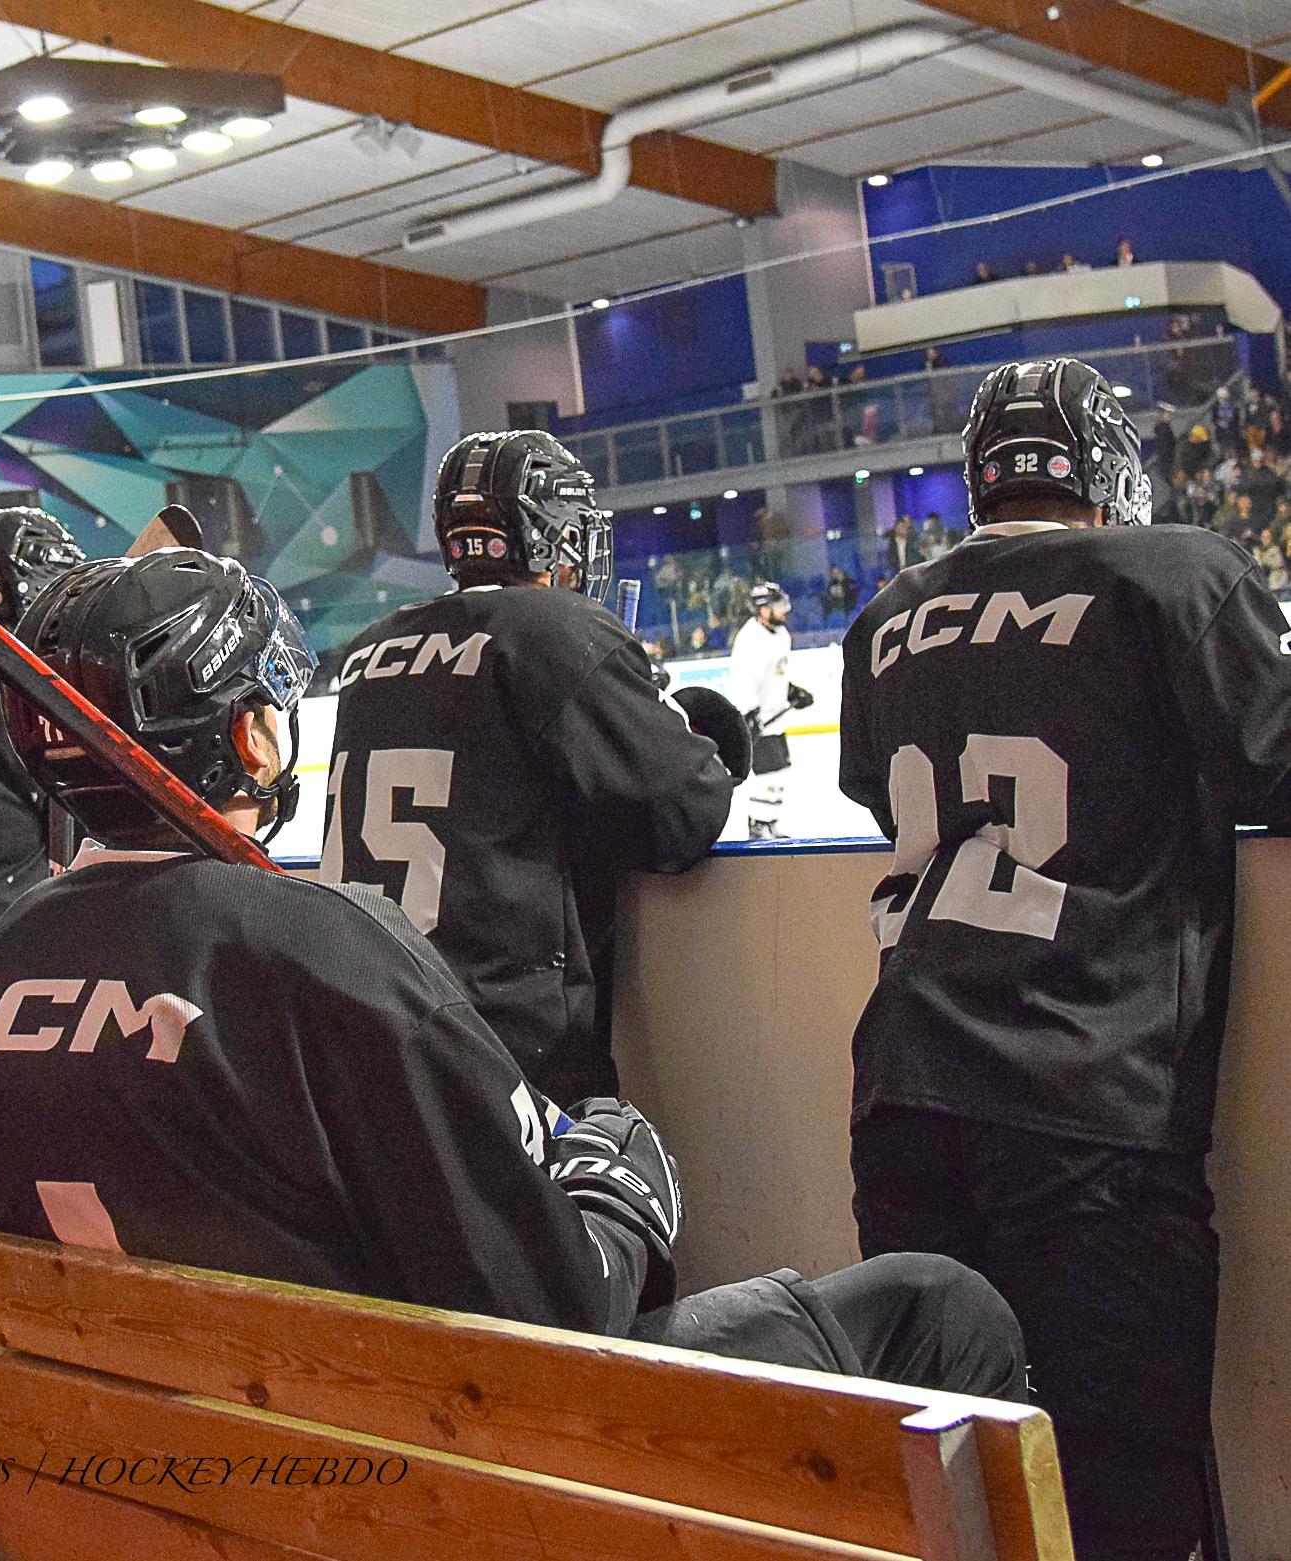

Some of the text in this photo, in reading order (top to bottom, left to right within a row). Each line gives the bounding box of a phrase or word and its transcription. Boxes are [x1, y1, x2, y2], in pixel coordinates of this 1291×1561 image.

[1014, 453, 1038, 473] 32
[466, 538, 483, 556] 15
[871, 591, 1095, 679] CCM
[339, 632, 492, 690] CCM
